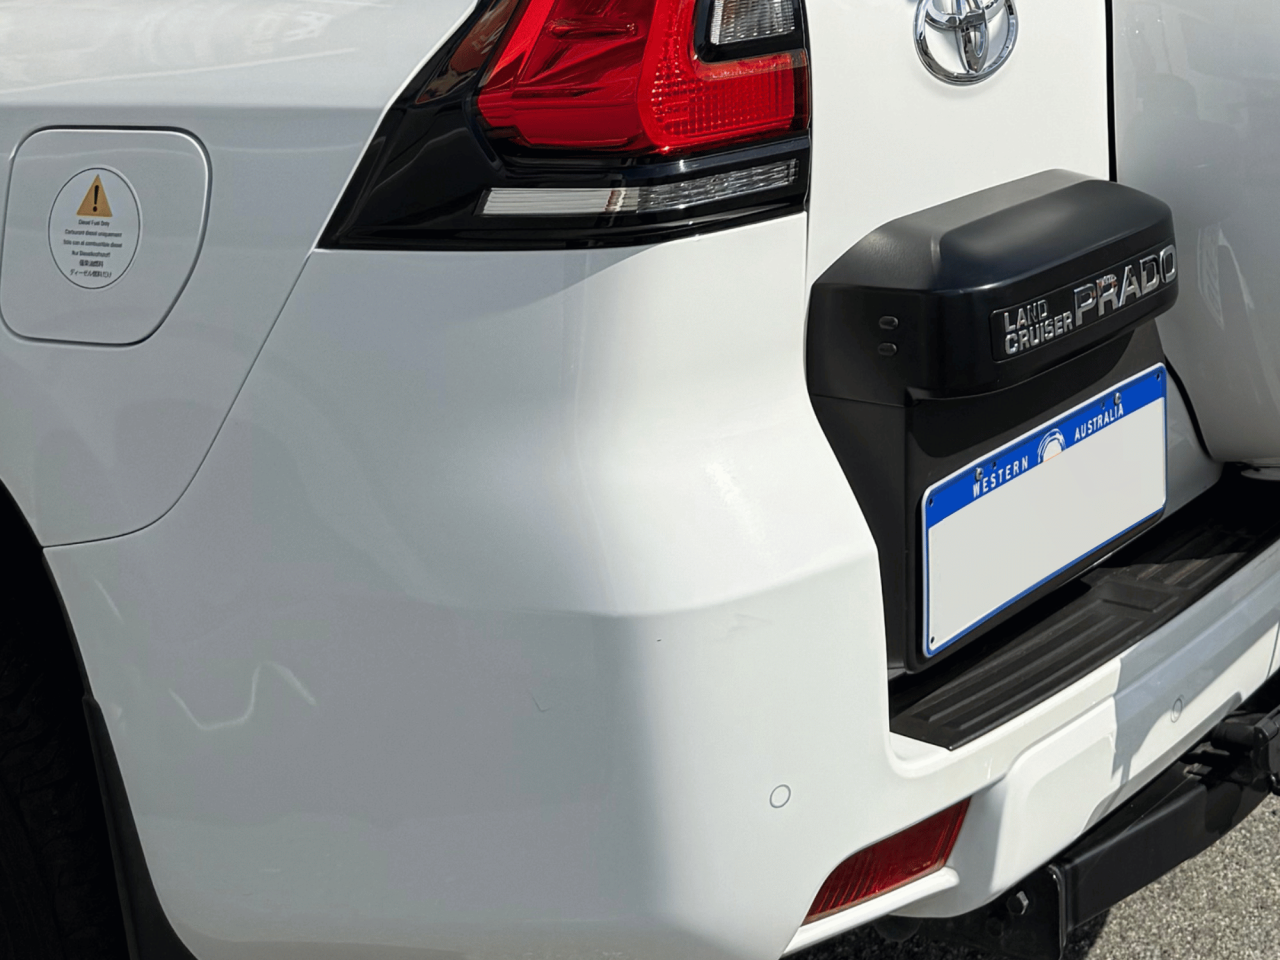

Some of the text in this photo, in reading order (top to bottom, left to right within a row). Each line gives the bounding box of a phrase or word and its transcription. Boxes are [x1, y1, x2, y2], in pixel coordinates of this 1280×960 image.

[1003, 299, 1048, 333] LAND
[1073, 244, 1177, 327] PRADO
[1004, 311, 1073, 355] CRUISER
[973, 402, 1124, 498] WESTERN AUSTRALIA
